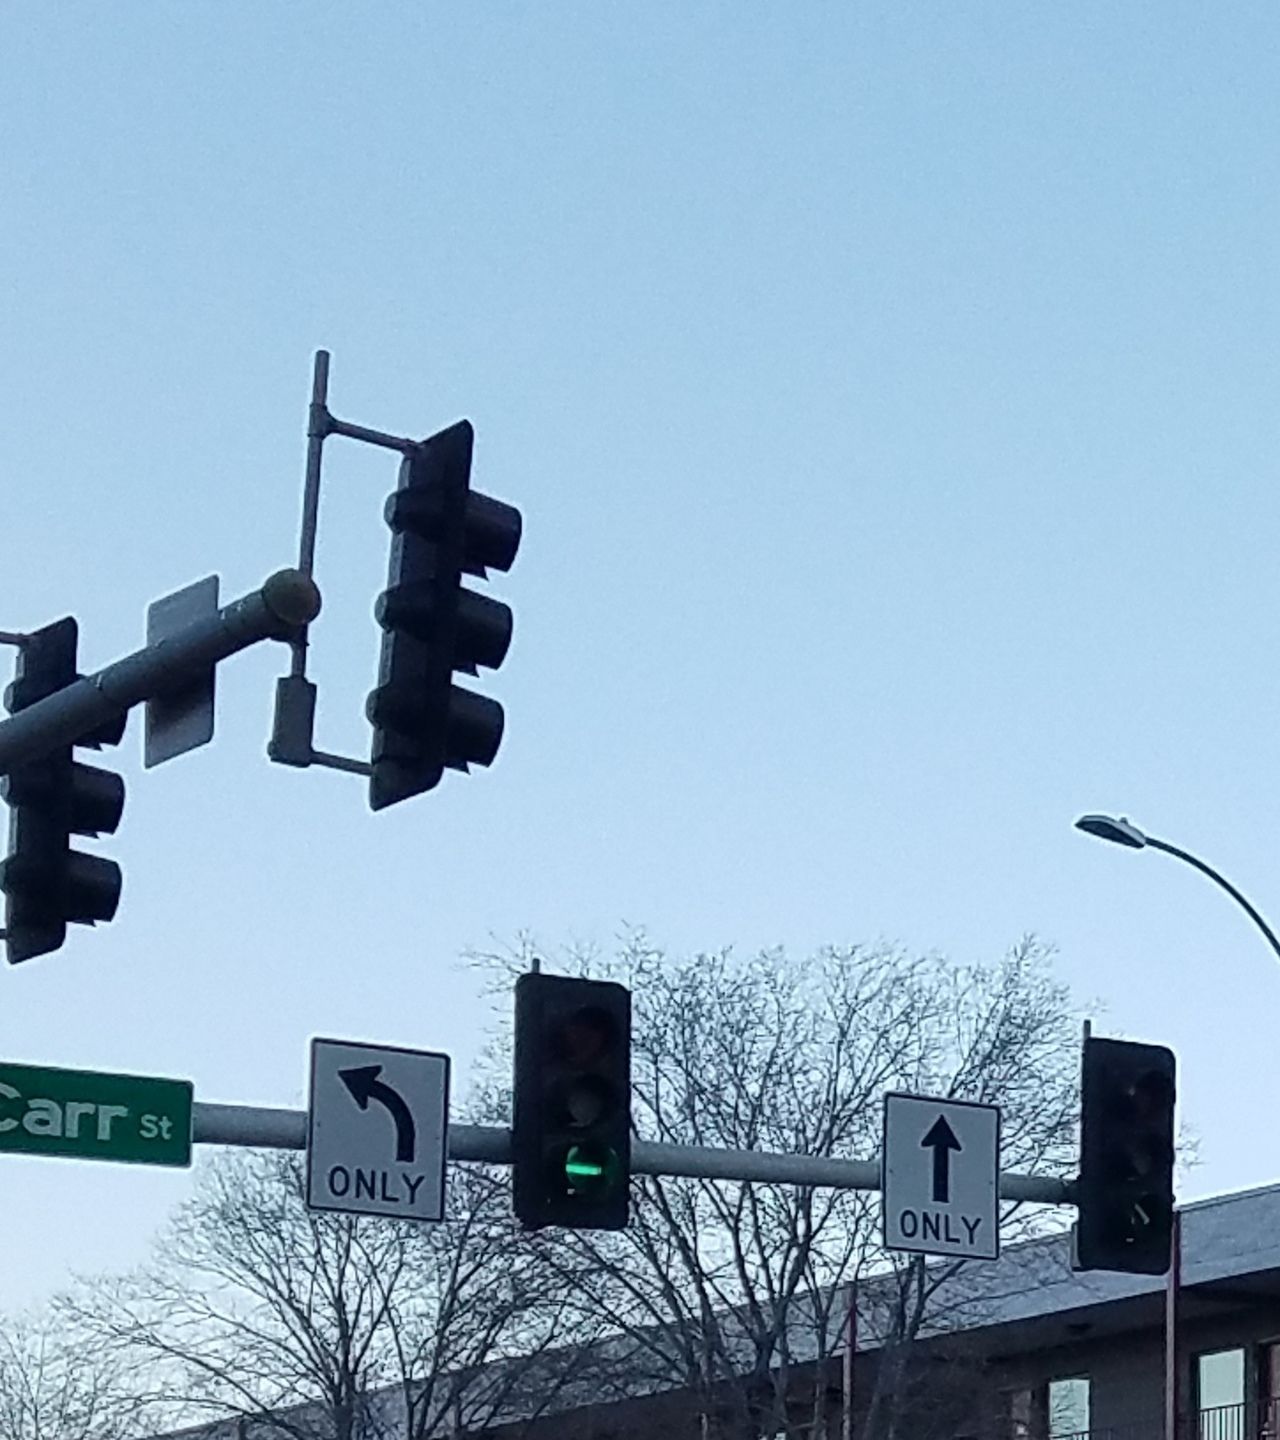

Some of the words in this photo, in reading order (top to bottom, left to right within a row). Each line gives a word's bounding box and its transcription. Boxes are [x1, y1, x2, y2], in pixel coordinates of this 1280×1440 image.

[139, 1113, 173, 1140] St
[328, 1165, 425, 1205] ONLY
[900, 1209, 982, 1245] ONLY
